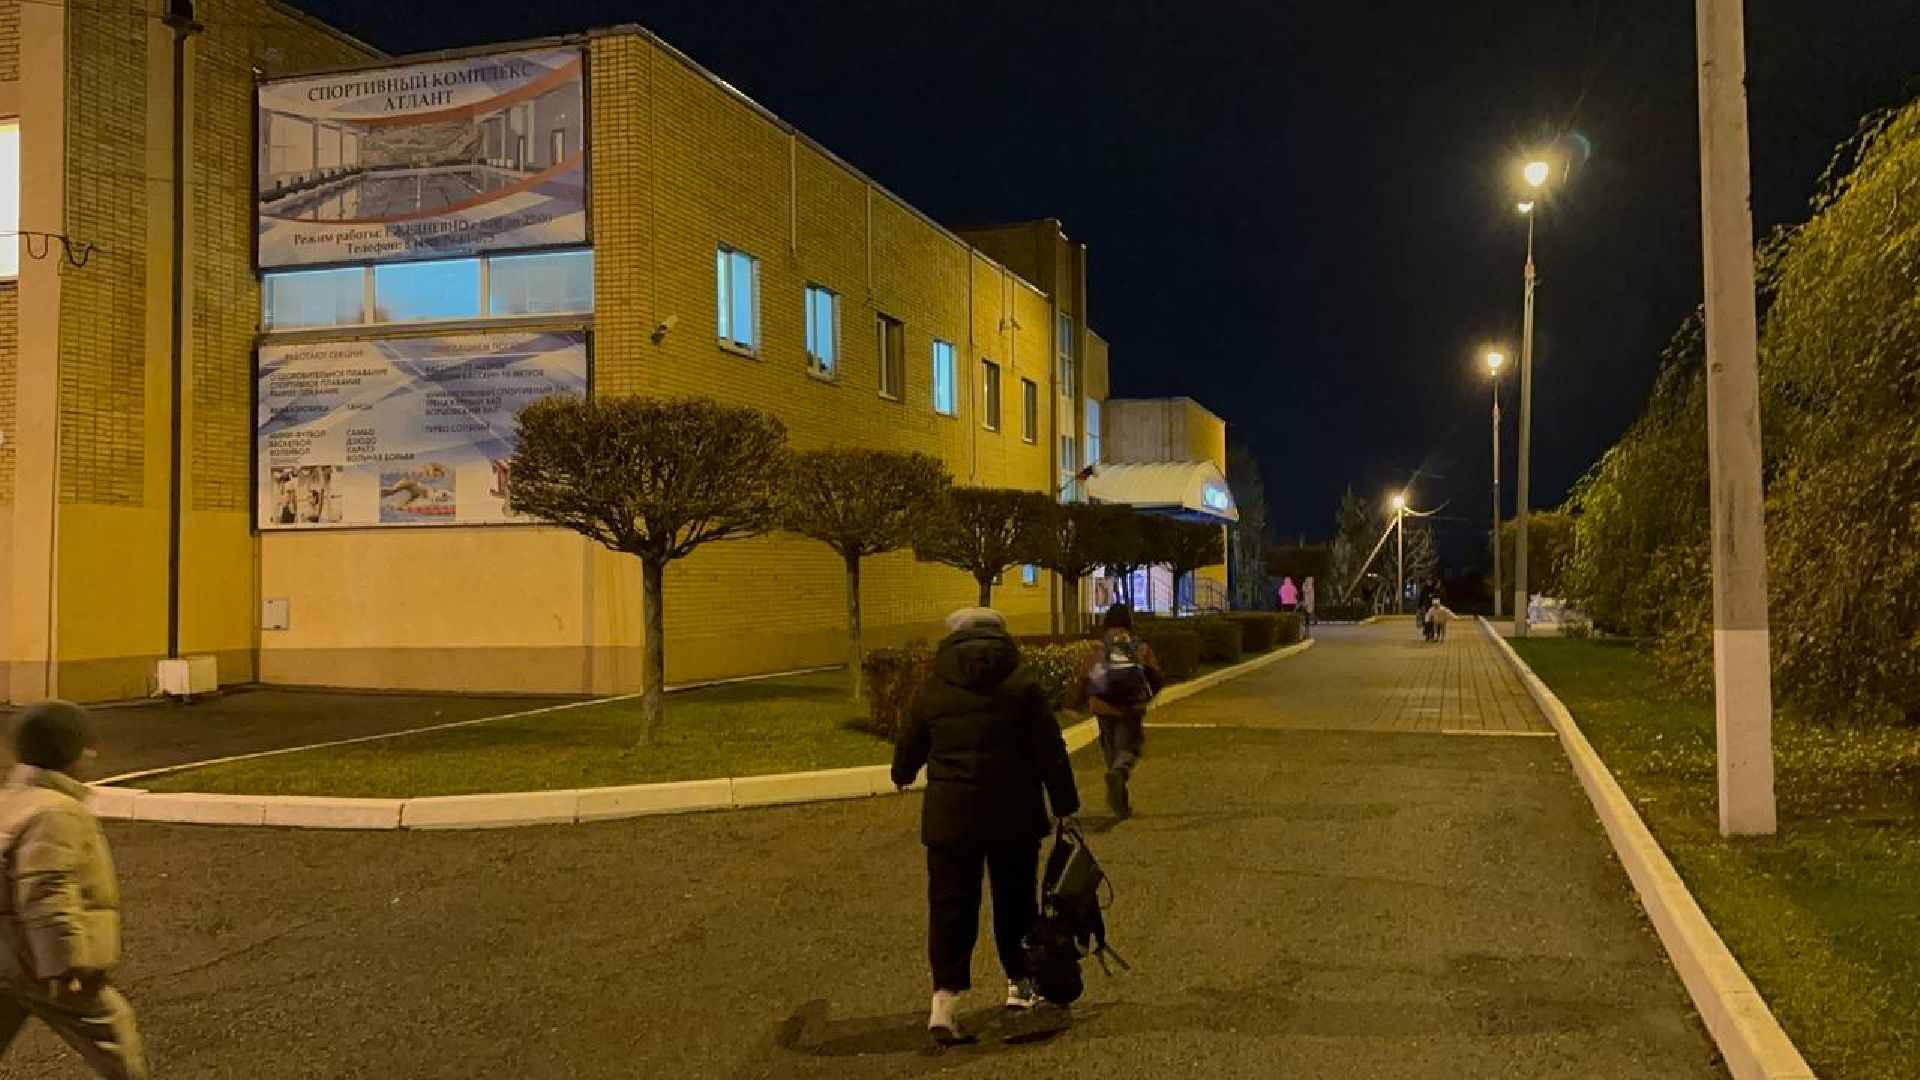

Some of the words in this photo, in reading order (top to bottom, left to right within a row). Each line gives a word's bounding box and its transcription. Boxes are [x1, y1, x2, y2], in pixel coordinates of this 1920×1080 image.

[308, 72, 428, 101] СПОРТИВНЫЙ
[432, 64, 529, 88] КОМПЛЕКС
[384, 90, 453, 111] АТЛАНТ
